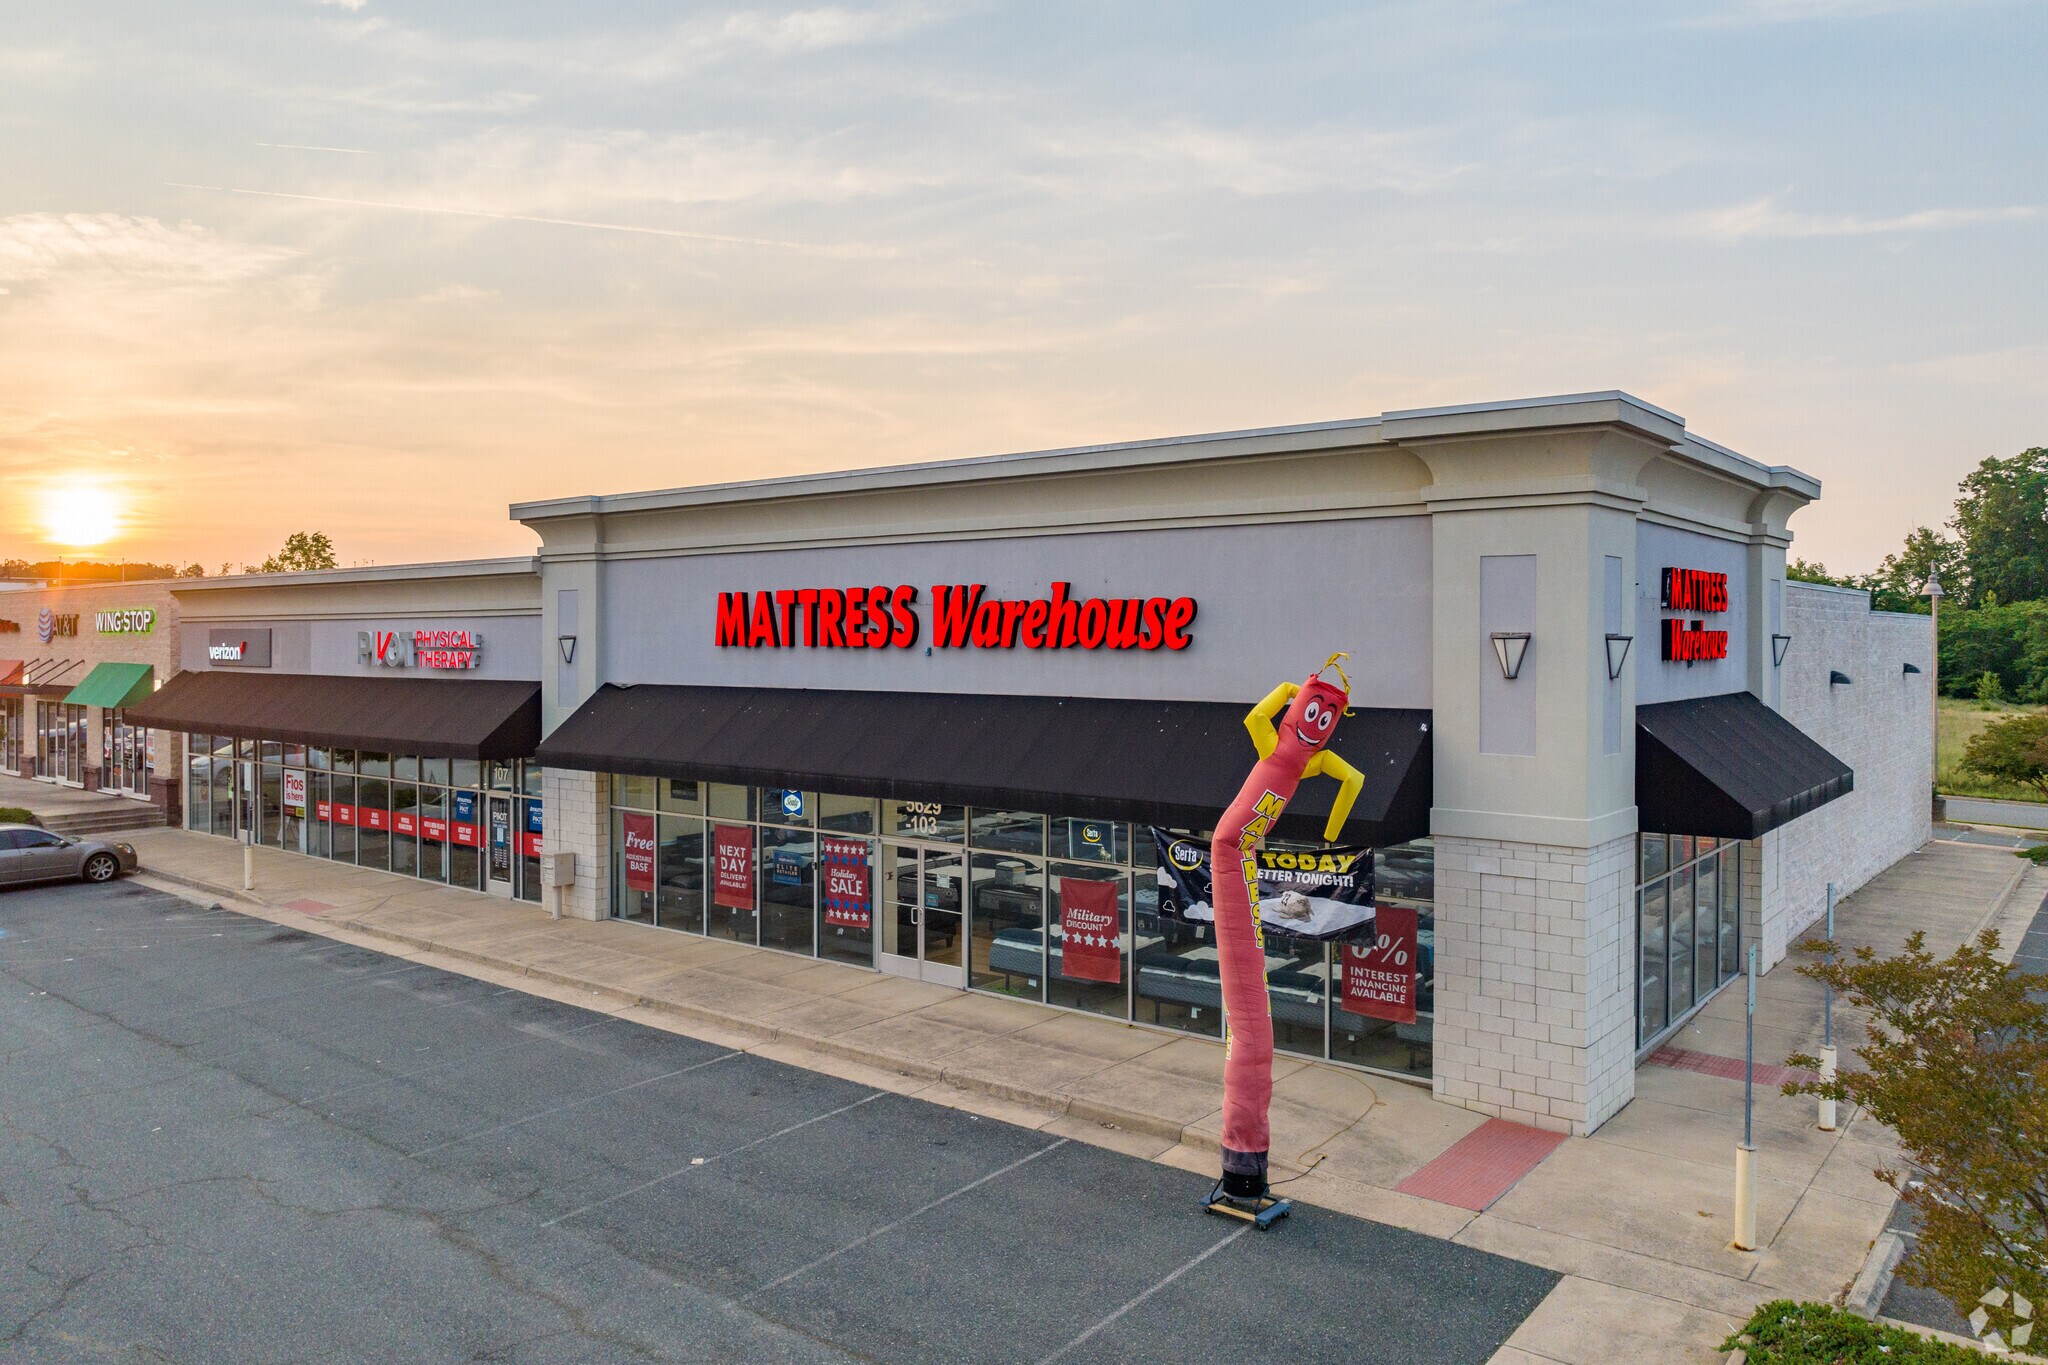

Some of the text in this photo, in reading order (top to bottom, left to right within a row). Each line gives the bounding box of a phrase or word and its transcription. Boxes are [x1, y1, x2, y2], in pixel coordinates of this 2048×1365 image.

[1669, 567, 1728, 612] MATTRESS
[714, 581, 1198, 650] MATTRESS Warehouse
[52, 613, 79, 637] AT&T
[416, 630, 475, 648] PHYSICAL
[1670, 618, 1728, 661] Warehouse
[209, 642, 241, 660] verizon
[358, 631, 415, 667] PIVOT
[418, 650, 473, 669] THERAPY
[286, 774, 304, 791] Fios
[493, 767, 509, 780] 107
[286, 791, 304, 802] is here
[625, 831, 654, 850] Free
[719, 844, 746, 858] NEXT
[1174, 845, 1197, 863] Serta
[630, 860, 648, 873] BASE
[720, 857, 746, 873] DAY
[1262, 852, 1356, 873] TODAY
[720, 871, 747, 882] DELIVERY
[830, 868, 858, 881] Holiday
[1257, 869, 1354, 887] ETTER TONIGHT!
[830, 879, 863, 896] SALE
[1066, 920, 1103, 931] DISCOUNT
[1067, 907, 1113, 926] Military
[1350, 966, 1408, 984] INTEREST
[1350, 977, 1407, 993] FINANCING
[1350, 987, 1406, 1004] AVAILABLE
